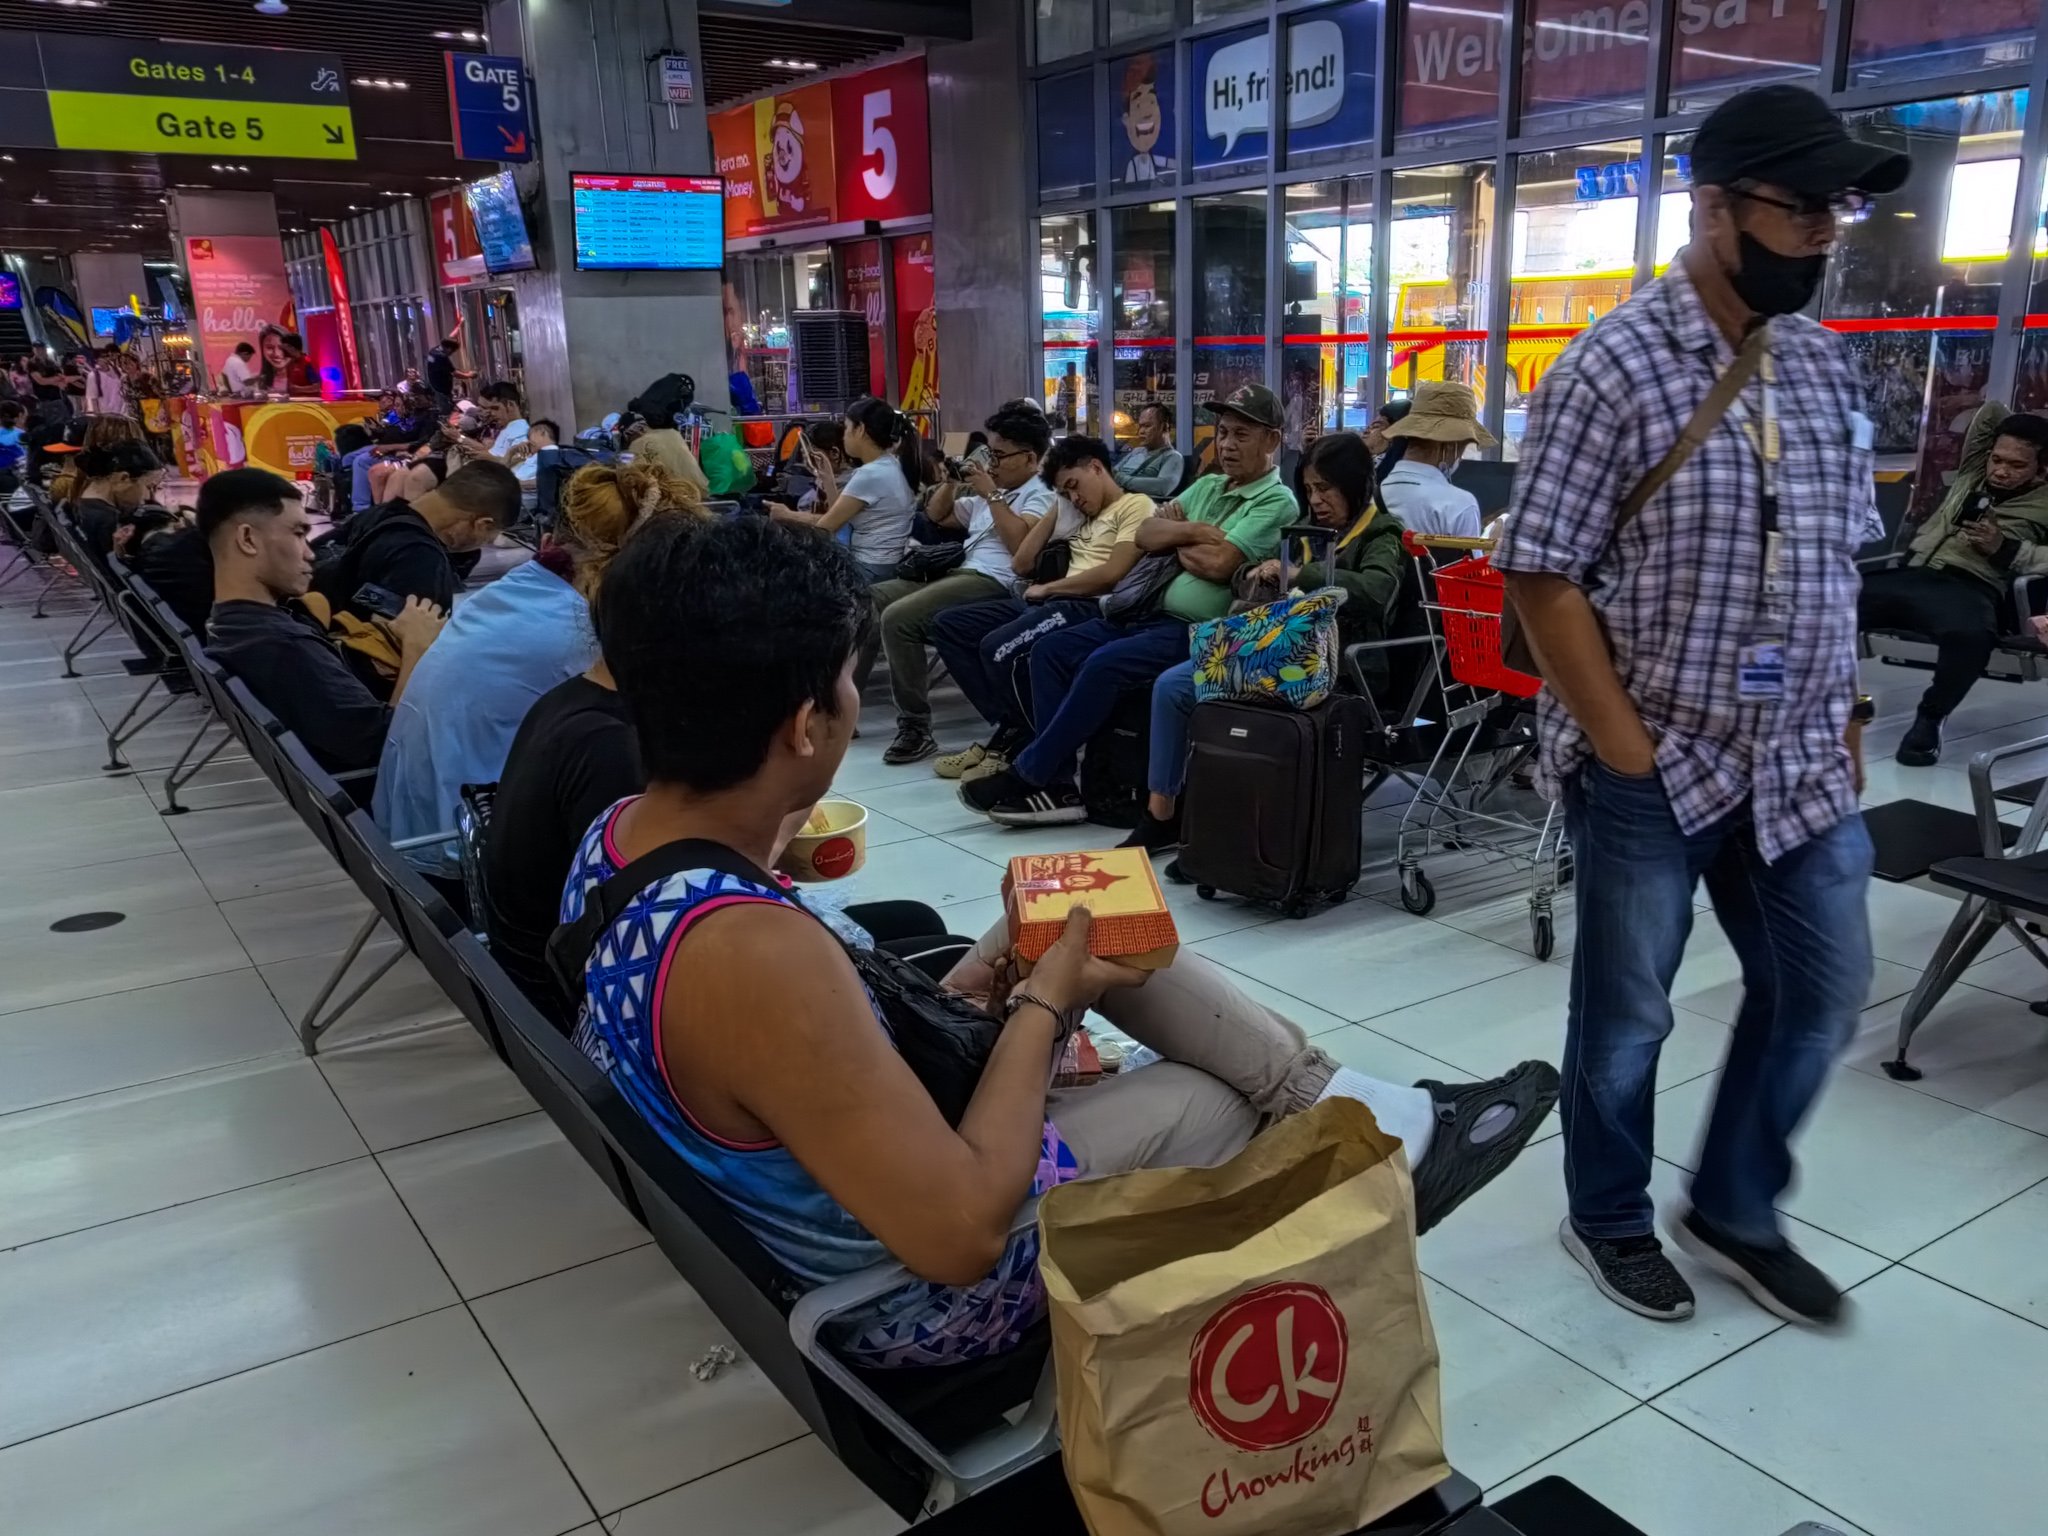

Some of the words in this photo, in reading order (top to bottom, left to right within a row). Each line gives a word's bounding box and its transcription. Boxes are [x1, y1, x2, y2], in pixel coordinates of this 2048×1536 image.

[130, 58, 205, 82] Gates
[215, 65, 257, 84] 1-4
[666, 60, 688, 70] FREE
[1213, 74, 1244, 112] Hi,
[1246, 54, 1335, 104] friend!
[502, 86, 520, 112] 5
[156, 112, 237, 140] Gate
[246, 118, 264, 141] 5
[862, 89, 898, 200] 5
[203, 306, 267, 333] hello
[1201, 1435, 1353, 1519] Chowking
